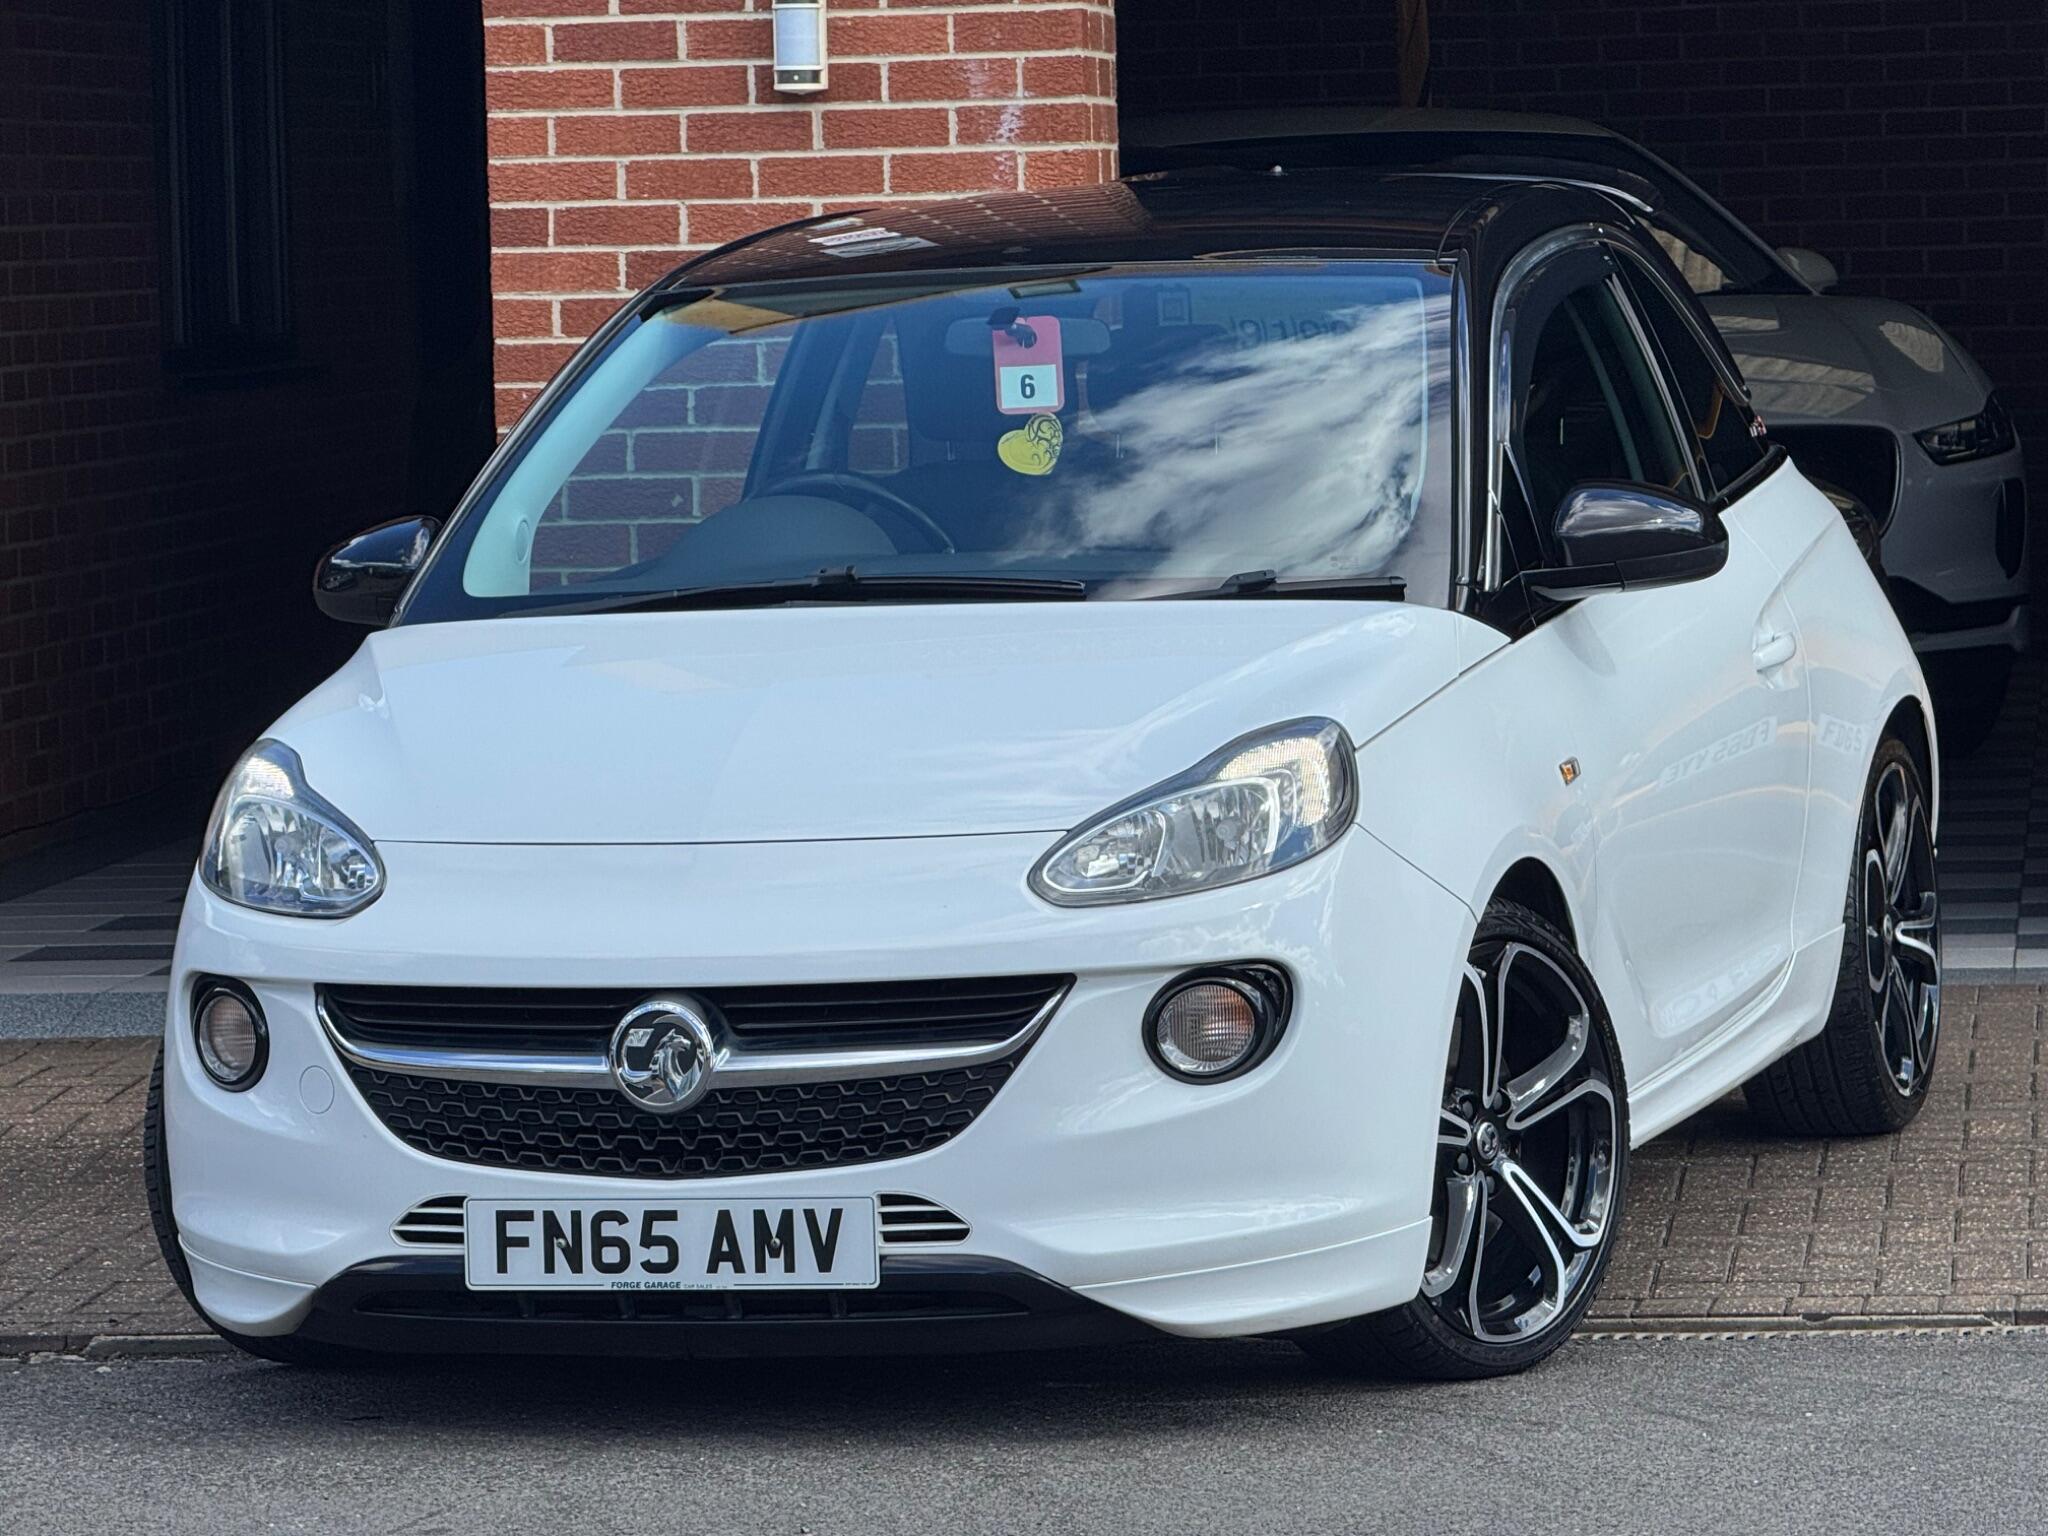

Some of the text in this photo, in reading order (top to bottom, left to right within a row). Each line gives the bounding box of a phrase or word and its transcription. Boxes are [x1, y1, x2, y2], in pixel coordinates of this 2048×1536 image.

[1020, 374, 1036, 399] 6
[495, 1207, 843, 1275] FN65 AMV
[611, 1281, 642, 1289] FORGE
[644, 1281, 682, 1289] GARAGE
